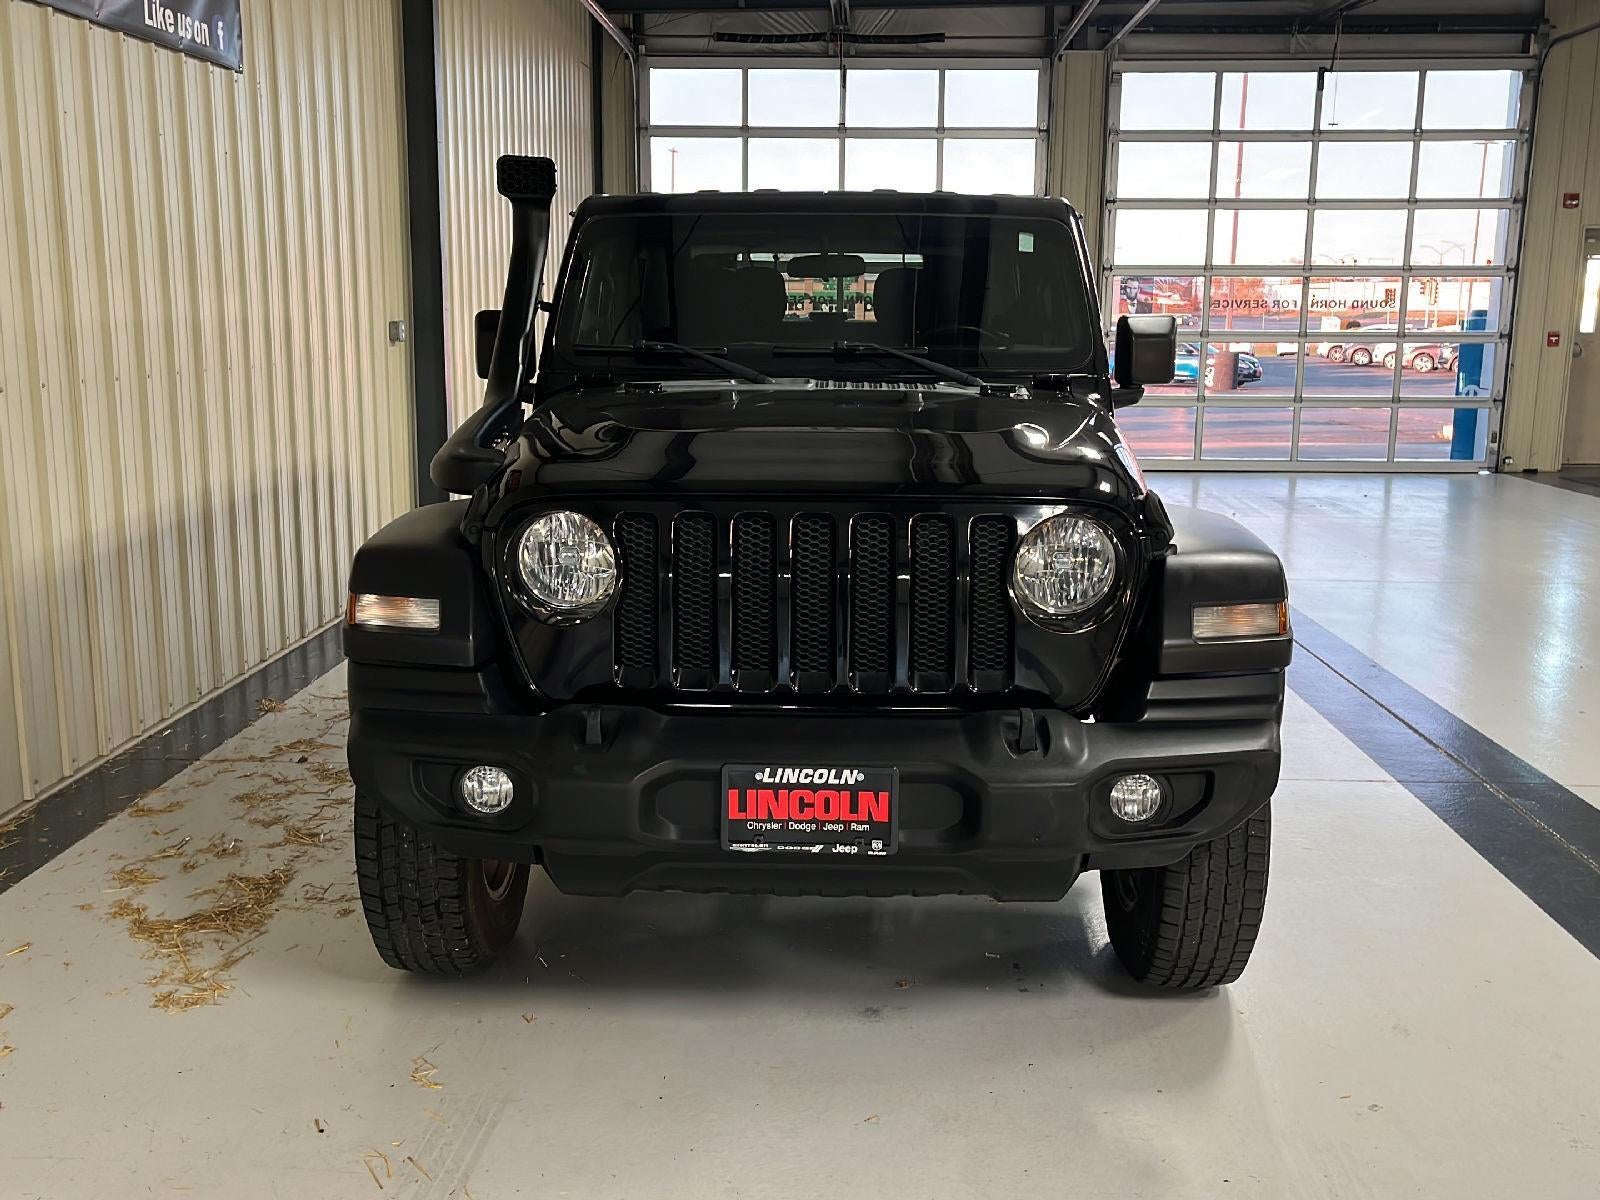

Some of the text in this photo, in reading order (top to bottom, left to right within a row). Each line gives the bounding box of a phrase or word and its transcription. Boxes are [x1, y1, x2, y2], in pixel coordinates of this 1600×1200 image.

[144, 0, 175, 34] Like
[177, 12, 193, 40] us
[193, 19, 210, 47] on
[762, 767, 859, 785] LINCOLN
[728, 789, 889, 823] LINCOLN
[746, 821, 870, 833] Chrysler Dodge Jeep Ram
[831, 844, 858, 855] Jeep
